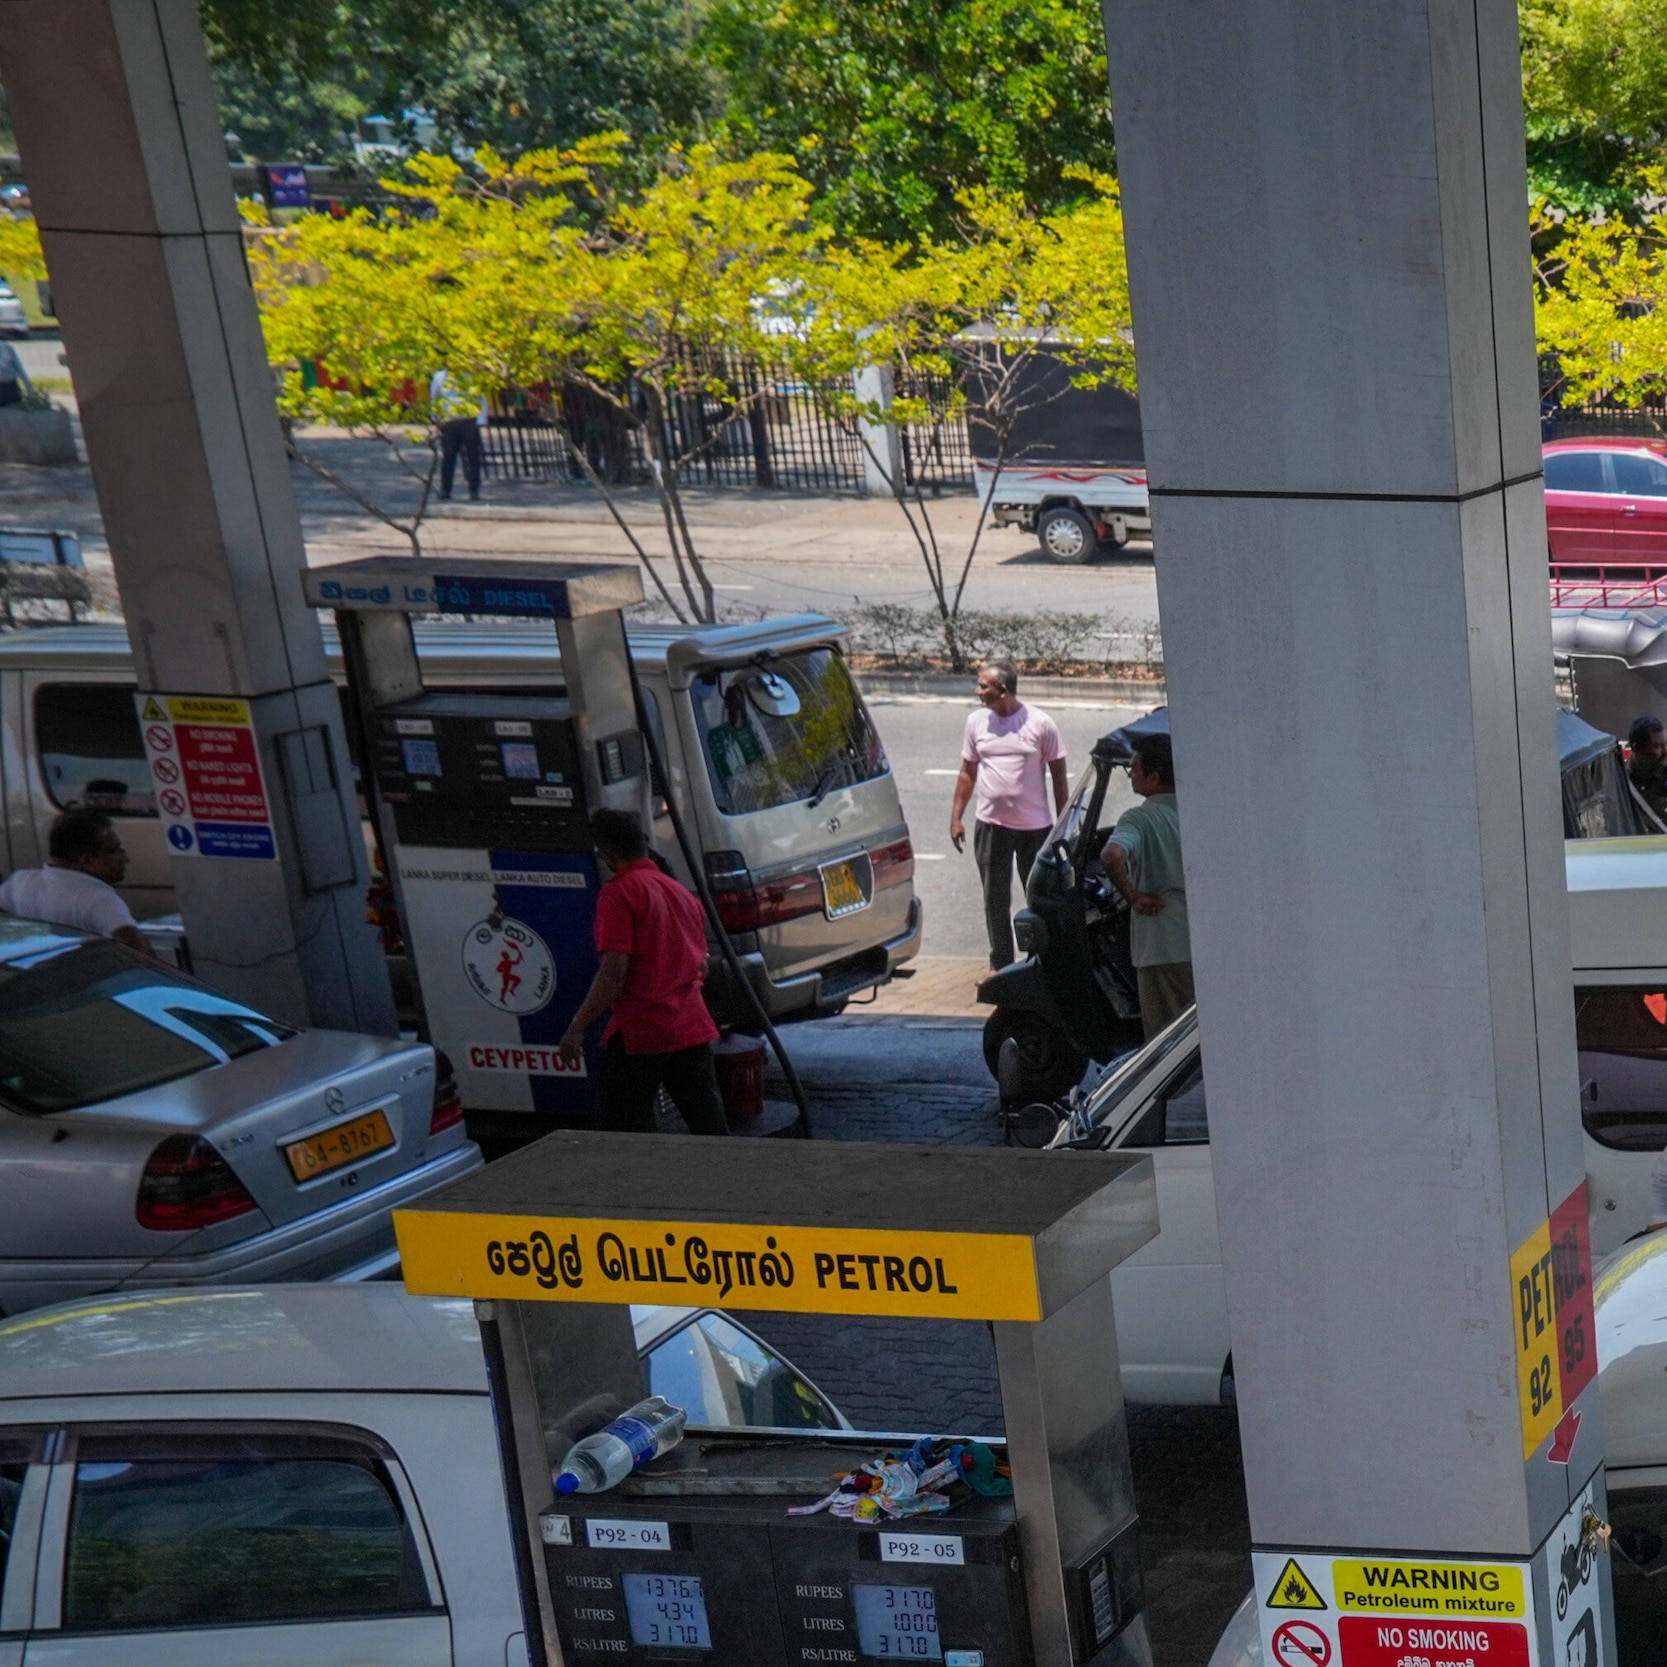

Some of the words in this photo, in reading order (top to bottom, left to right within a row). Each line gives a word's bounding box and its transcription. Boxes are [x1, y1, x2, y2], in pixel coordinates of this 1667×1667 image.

[483, 589, 551, 607] DIESEL
[402, 869, 430, 880] LANKA
[432, 871, 460, 881] SUPER
[462, 872, 490, 882] DIESEL
[495, 873, 524, 884] LANKA
[528, 875, 551, 885] AUTO
[553, 876, 582, 886] DIESEL
[534, 966, 552, 999] LANKA
[597, 1232, 795, 1300] பெட்ரோல்
[814, 1253, 958, 1294] PETROL
[1519, 1222, 1585, 1351] PETROL
[1530, 1354, 1552, 1417] 92
[1564, 1313, 1584, 1374] 95
[595, 1528, 627, 1543] P92
[641, 1529, 663, 1543] 04
[888, 1542, 920, 1557] P92
[934, 1544, 956, 1557] 05
[566, 1575, 613, 1590] RUPEES
[1363, 1566, 1501, 1592] WARNING
[795, 1584, 844, 1599] RUPEES
[1344, 1591, 1439, 1609] Petroleum
[1444, 1594, 1516, 1612] mixture
[574, 1607, 616, 1622] LITRES
[658, 1602, 694, 1621] 4.34
[803, 1617, 845, 1631] LITRES
[573, 1638, 628, 1652] RS/LITRE
[1377, 1626, 1402, 1649] NO
[1408, 1628, 1490, 1651] SMOKING
[801, 1647, 857, 1663] RS/LITRE
